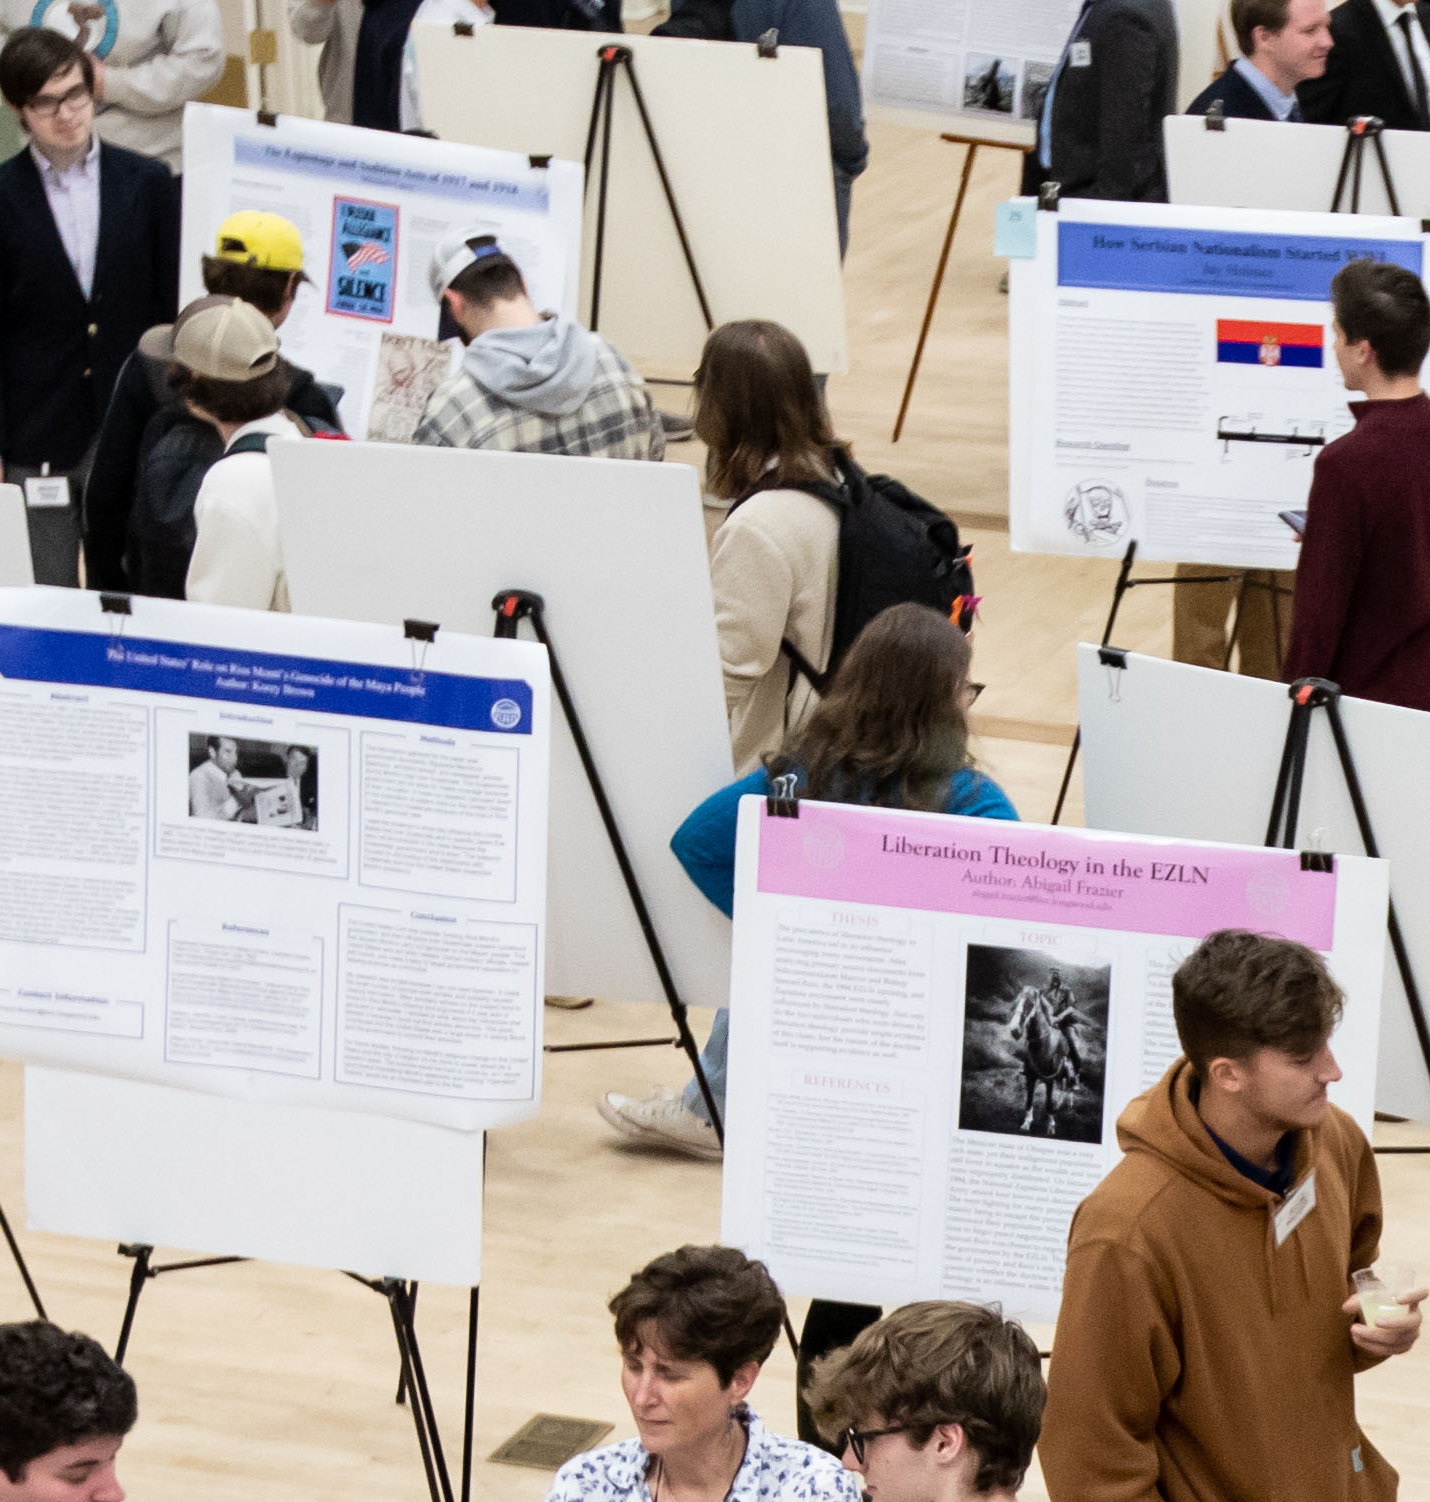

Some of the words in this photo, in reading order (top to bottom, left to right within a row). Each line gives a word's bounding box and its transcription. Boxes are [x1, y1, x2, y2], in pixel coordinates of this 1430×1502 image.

[882, 834, 981, 861] Liberation
[990, 846, 1079, 874] Theology
[1085, 856, 1104, 874] in
[1112, 858, 1143, 878] the
[1150, 862, 1208, 884] EZLN
[1021, 874, 1071, 894] Abigail
[1076, 880, 1124, 898] Frazier
